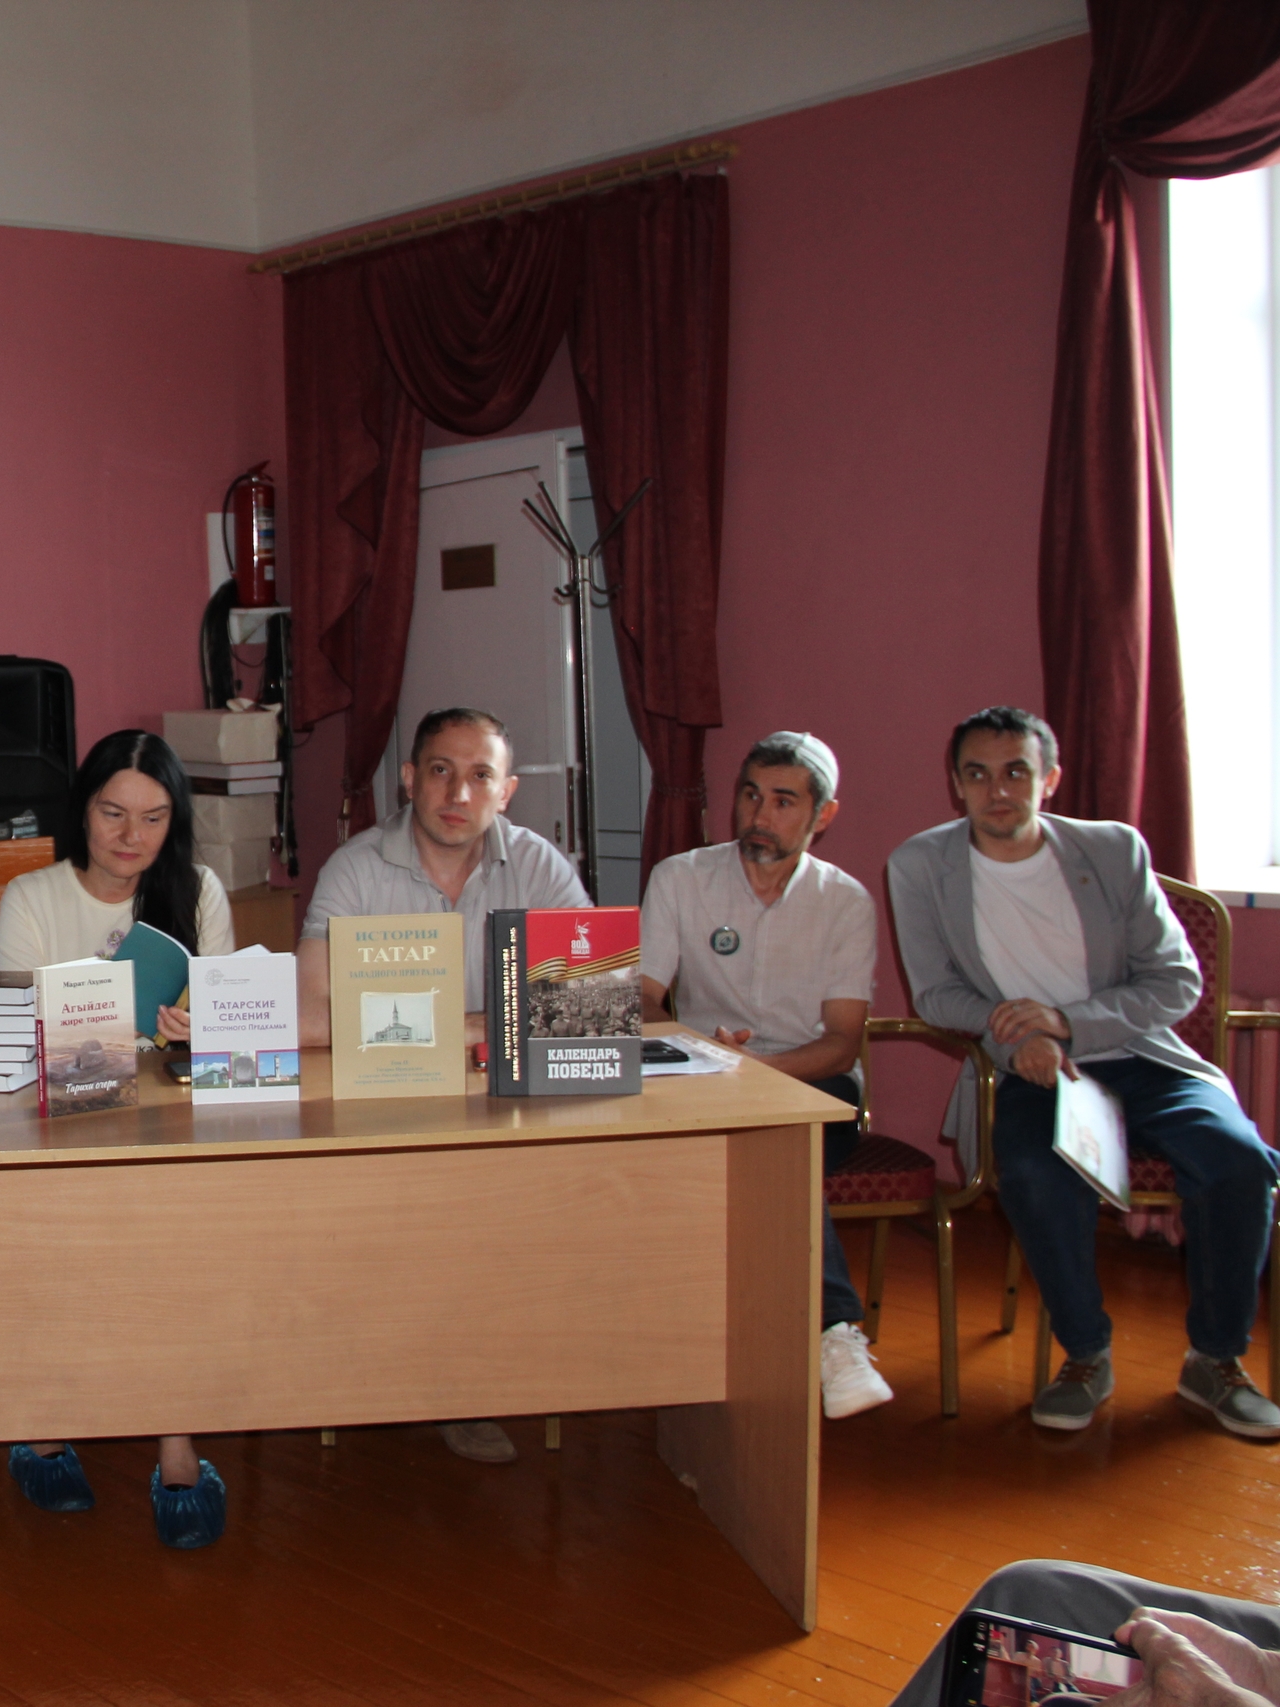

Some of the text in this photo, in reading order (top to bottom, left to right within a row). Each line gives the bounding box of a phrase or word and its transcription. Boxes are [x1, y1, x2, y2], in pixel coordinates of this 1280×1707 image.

[355, 929, 438, 942] ИСТОРИЯ
[357, 945, 436, 963] ТАТАР
[349, 967, 447, 979] ЗАПАДНОГО ПРИУРАЛЬЯ
[87, 978, 112, 986] Ахунов
[61, 1000, 115, 1014] Агыйдел
[87, 1013, 118, 1025] тарихы
[219, 1012, 270, 1021] СЕЛЕНИЯ
[547, 1048, 621, 1061] КАЛЕНДАРЬ
[547, 1062, 621, 1080] ПОБЕДЫ
[65, 1079, 117, 1096] Тарихи очерк
